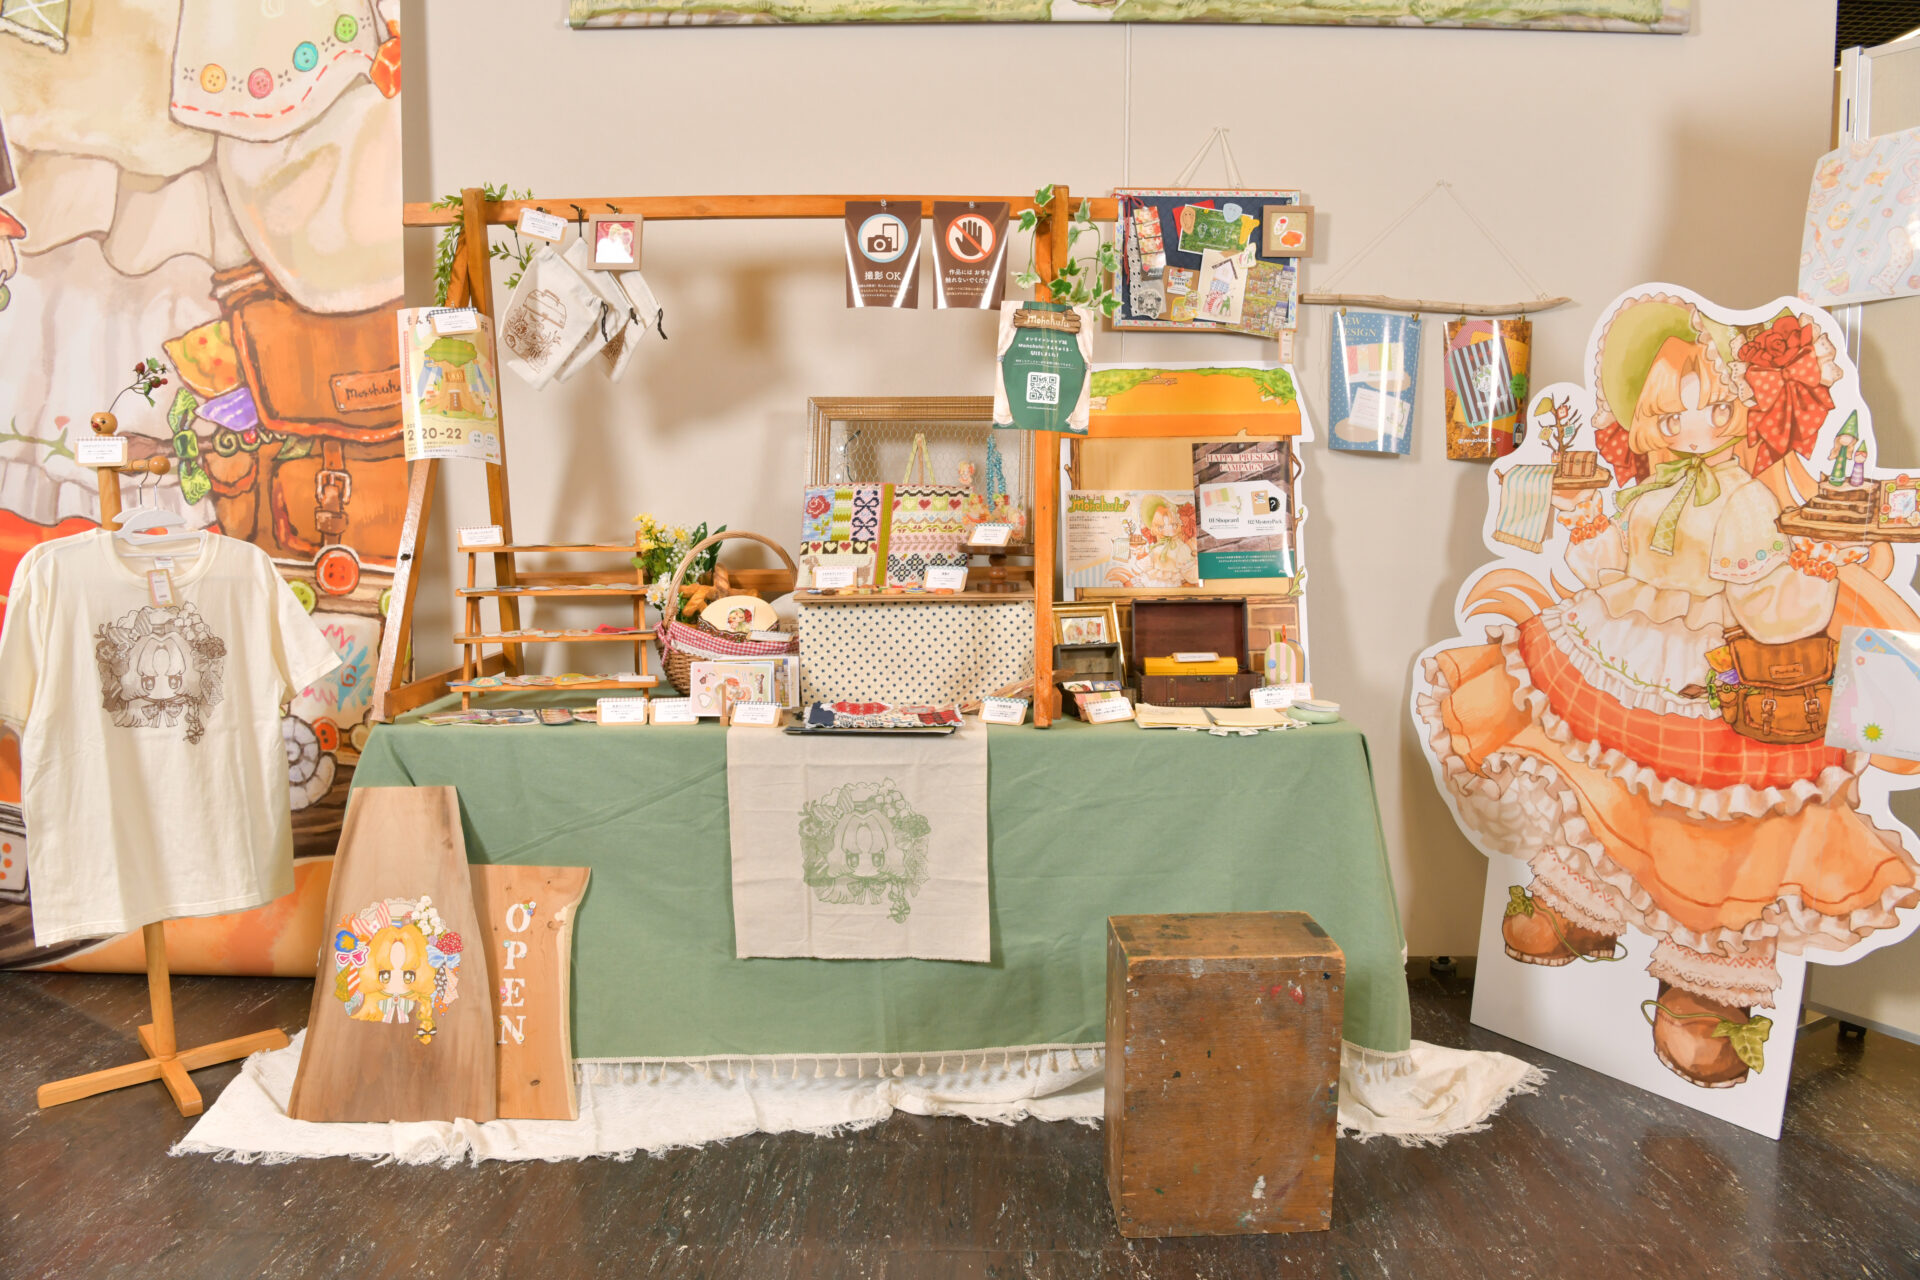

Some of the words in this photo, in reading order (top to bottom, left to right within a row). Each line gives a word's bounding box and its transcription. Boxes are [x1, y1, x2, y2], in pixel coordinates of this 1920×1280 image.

[886, 271, 901, 280] OK
[1206, 453, 1234, 462] HAPPY
[1239, 452, 1277, 462] PRESENT
[1220, 463, 1264, 472] CAMPAIGN
[1068, 493, 1090, 501] What
[498, 902, 533, 1045] OPEN
